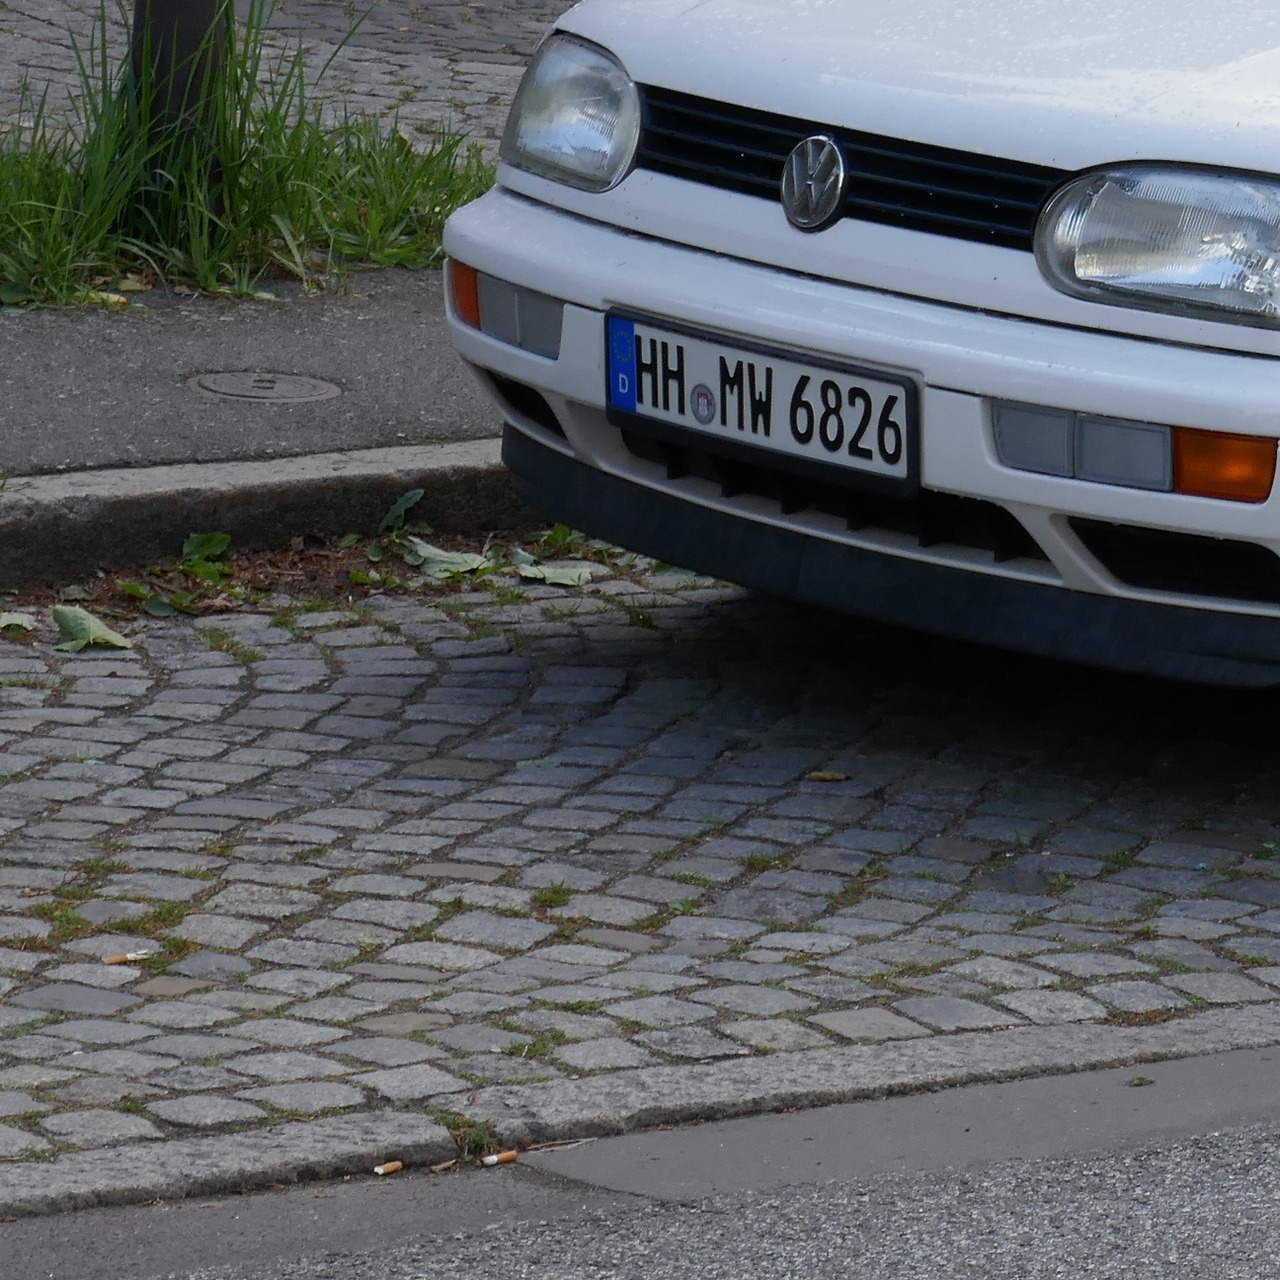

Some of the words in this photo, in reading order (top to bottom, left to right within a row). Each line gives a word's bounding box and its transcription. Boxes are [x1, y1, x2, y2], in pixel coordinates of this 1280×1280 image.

[618, 373, 629, 394] D
[634, 334, 686, 416] HH
[719, 355, 773, 438] MW
[789, 375, 903, 466] 6826
